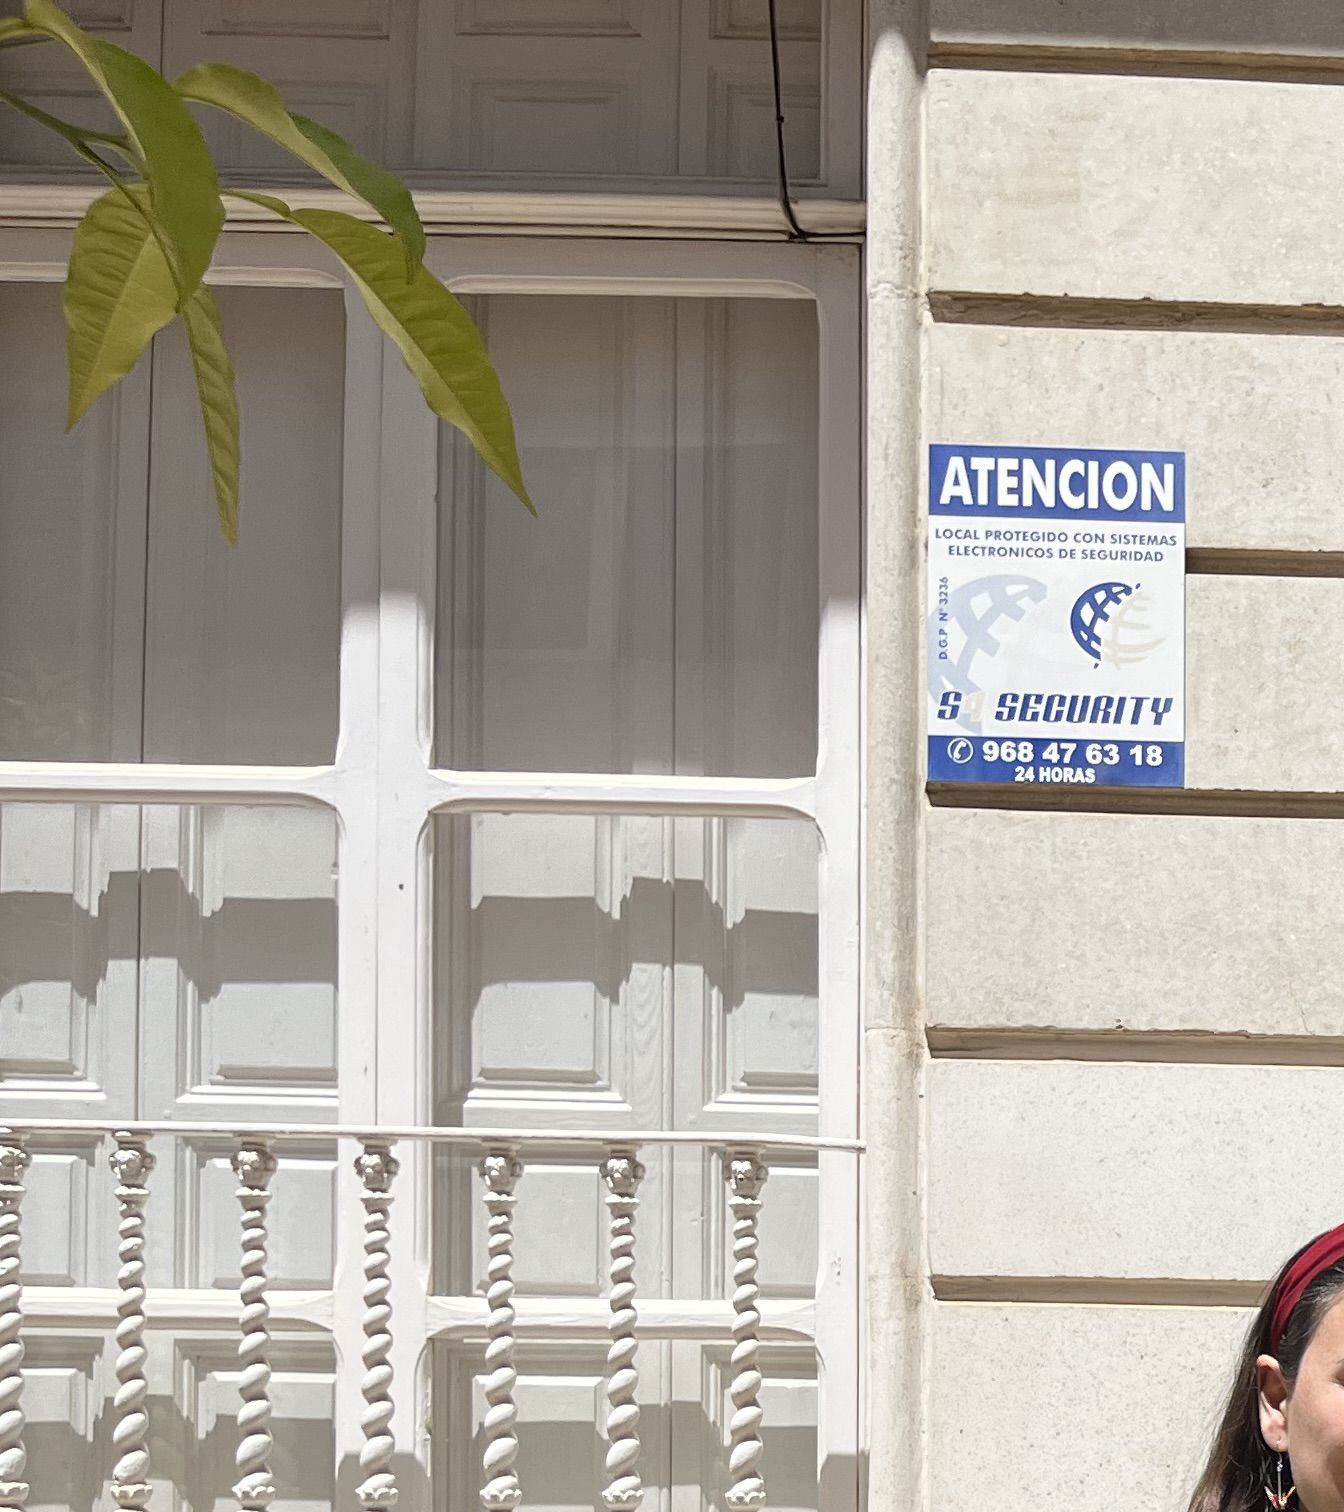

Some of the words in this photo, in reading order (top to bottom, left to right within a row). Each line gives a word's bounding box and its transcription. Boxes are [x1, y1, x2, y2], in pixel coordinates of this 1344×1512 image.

[939, 456, 1175, 511] ATENCION
[935, 528, 980, 540] LOCAL
[985, 530, 1068, 543] PROTEGIDO
[1073, 533, 1106, 545] CON
[1110, 533, 1178, 546] SISTEMAS
[948, 545, 1054, 559] ELECTRONICOS
[1058, 548, 1077, 560] DE
[1081, 549, 1165, 562] SEGURIDAD
[994, 692, 1174, 726] SECURITY
[982, 740, 1035, 763] 968
[1042, 742, 1077, 764] 47
[1085, 743, 1120, 766] 63
[1129, 745, 1163, 767] 18
[1014, 766, 1035, 783] 24
[1038, 766, 1096, 784] HORAS
